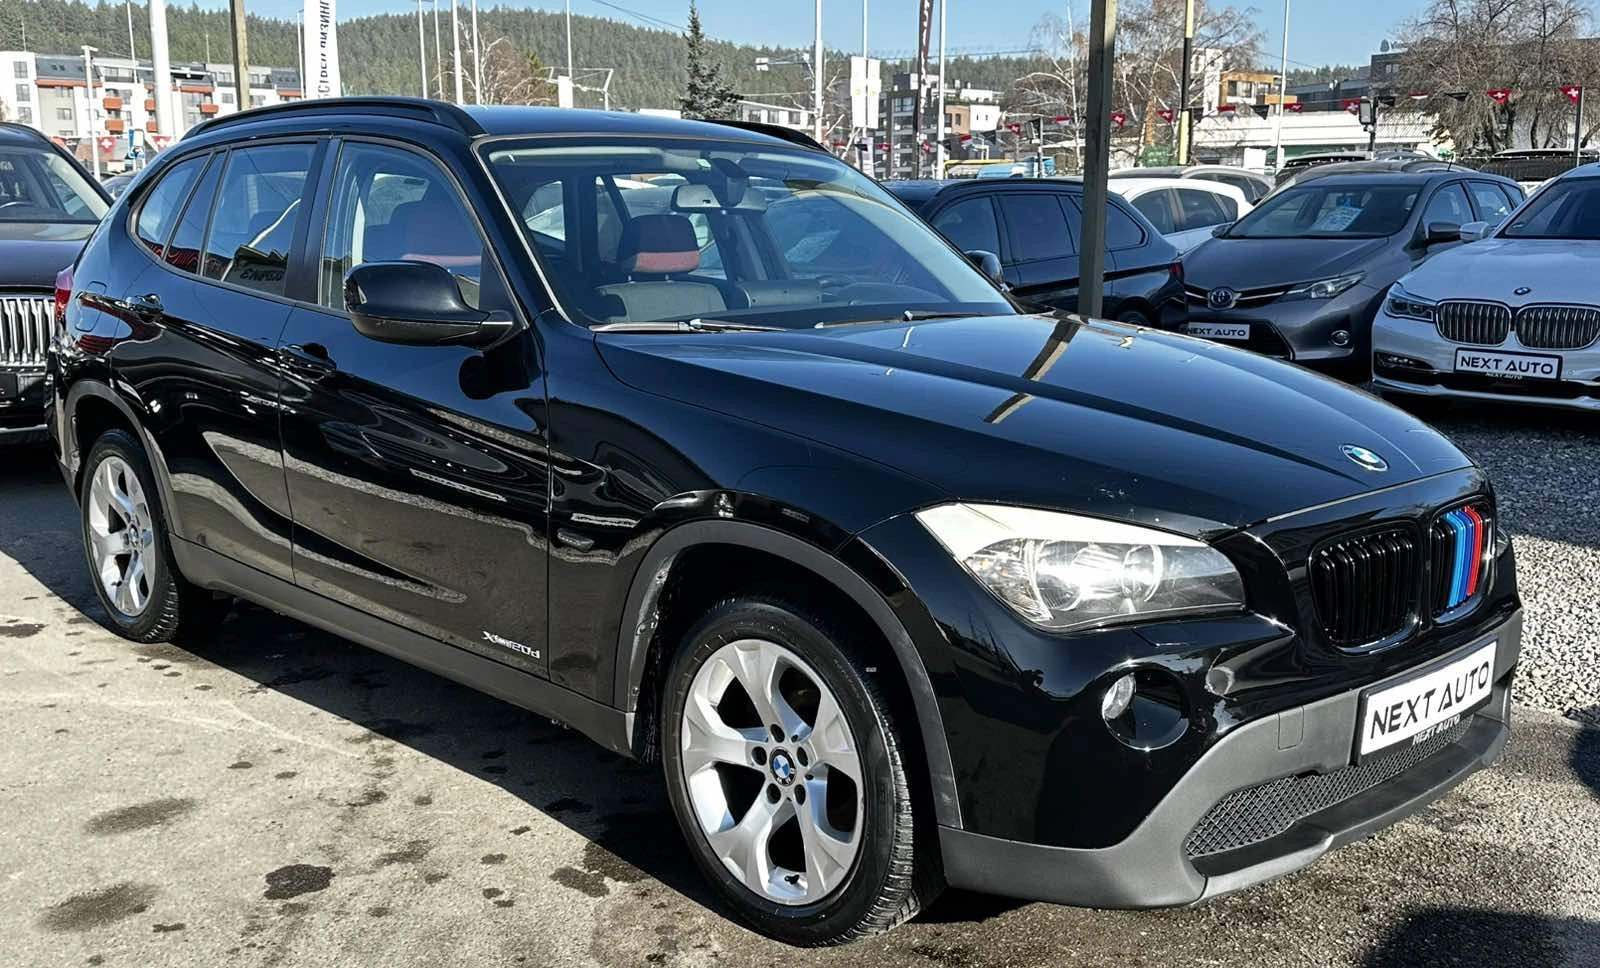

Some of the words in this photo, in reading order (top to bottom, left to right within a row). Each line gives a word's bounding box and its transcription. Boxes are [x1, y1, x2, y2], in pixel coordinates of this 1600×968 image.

[1214, 329, 1246, 337] AUTO
[1460, 356, 1503, 370] NEXT
[1505, 360, 1554, 375] AUTO
[1370, 688, 1437, 740] NEXT
[1437, 661, 1490, 713] AUTO
[1412, 725, 1437, 746] NEXT
[1436, 713, 1461, 734] AUTO
